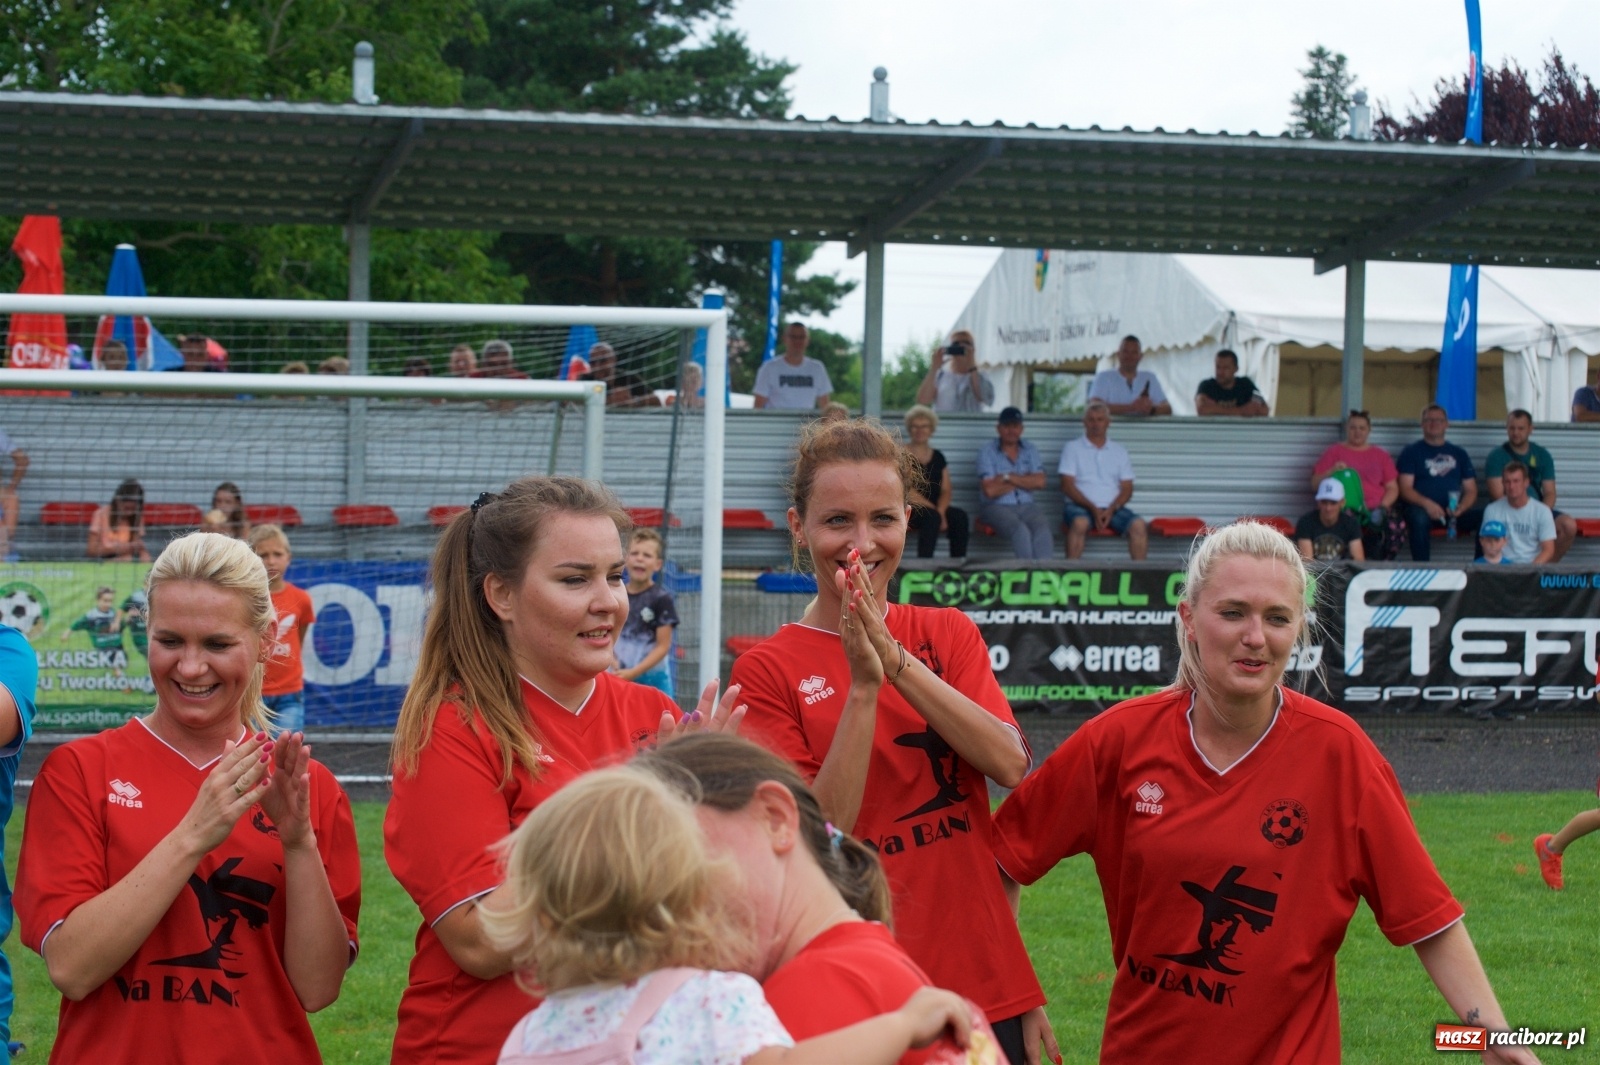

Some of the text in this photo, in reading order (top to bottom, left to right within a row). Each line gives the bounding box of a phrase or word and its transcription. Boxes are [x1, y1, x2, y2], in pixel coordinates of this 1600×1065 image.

[899, 571, 1149, 606] FOOTBALL
[1080, 610, 1181, 625] HURTOWN
[1084, 645, 1161, 672] errea
[804, 686, 835, 705] errea
[108, 792, 143, 809] errea
[1135, 801, 1163, 815] errea
[114, 975, 150, 1002] Va
[1127, 954, 1237, 1008] Va BANK
